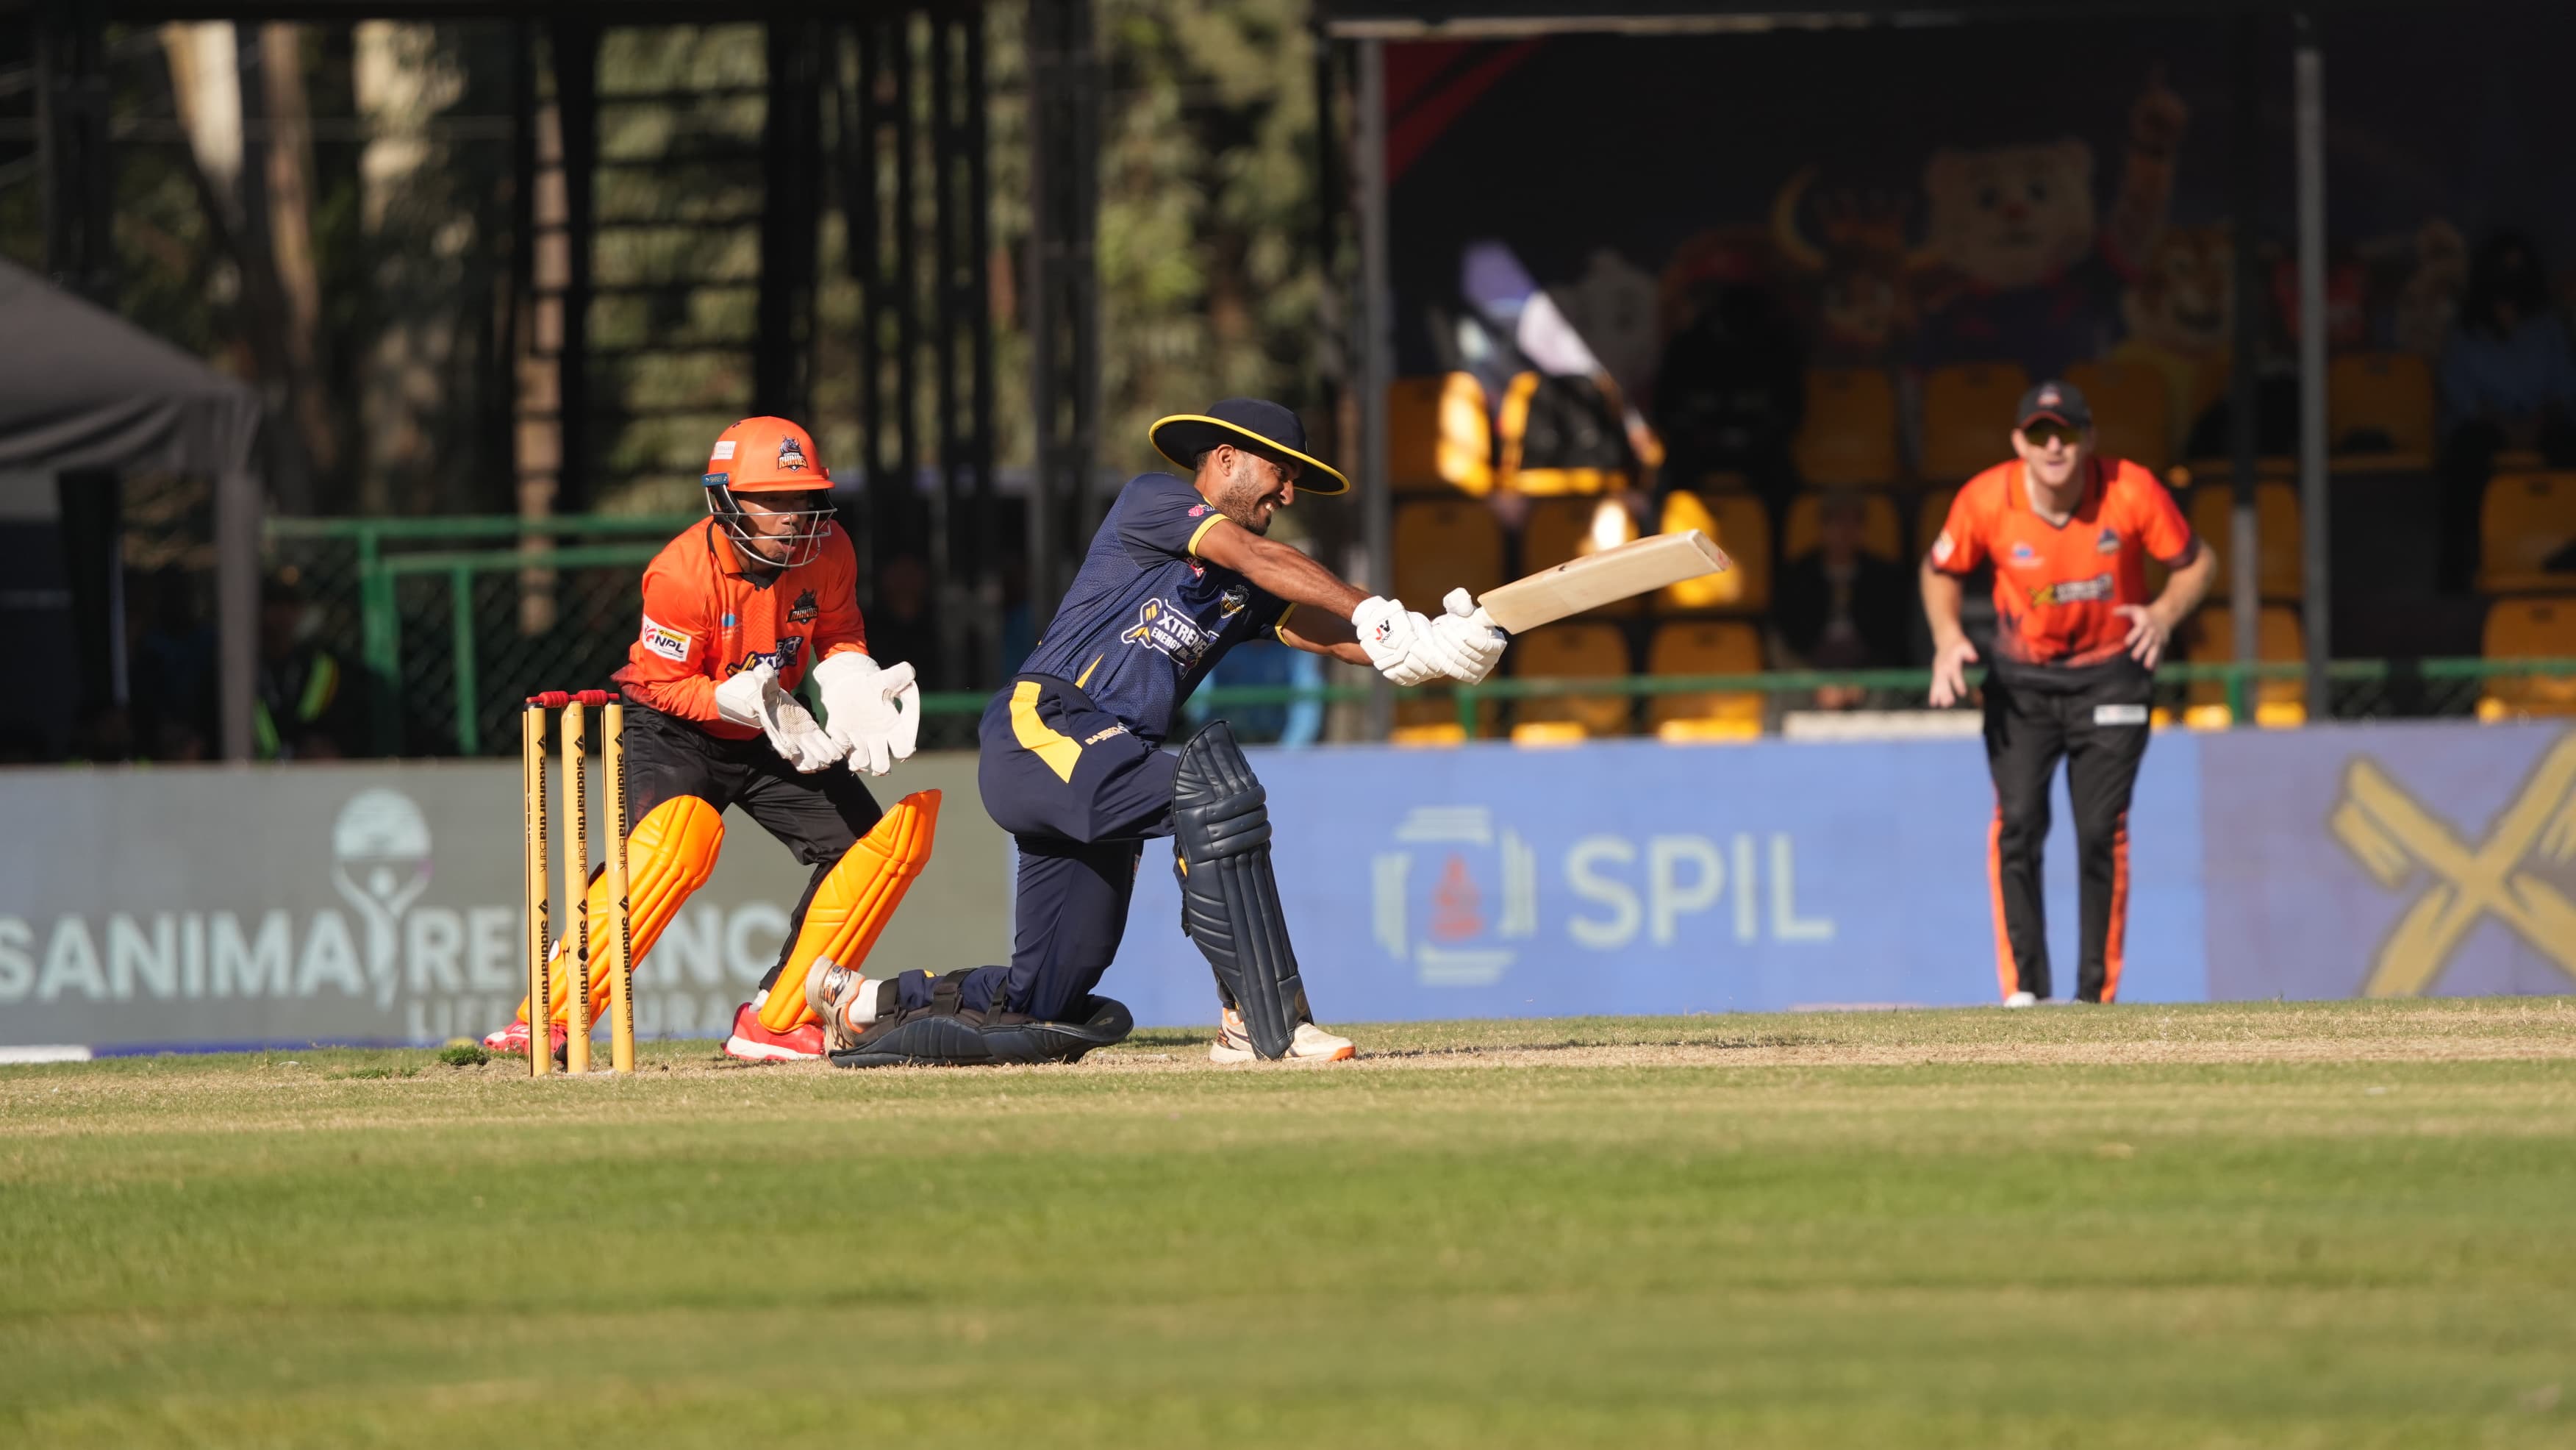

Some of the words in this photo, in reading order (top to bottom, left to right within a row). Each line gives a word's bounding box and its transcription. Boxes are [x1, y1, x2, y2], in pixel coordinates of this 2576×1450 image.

[779, 455, 807, 469] RHINOS
[654, 635, 684, 653] NPL
[1151, 626, 1182, 651] ENERGY
[1156, 610, 1207, 654] XTREME
[1564, 831, 1836, 949] SPIL
[0, 908, 365, 1003] SANIMA
